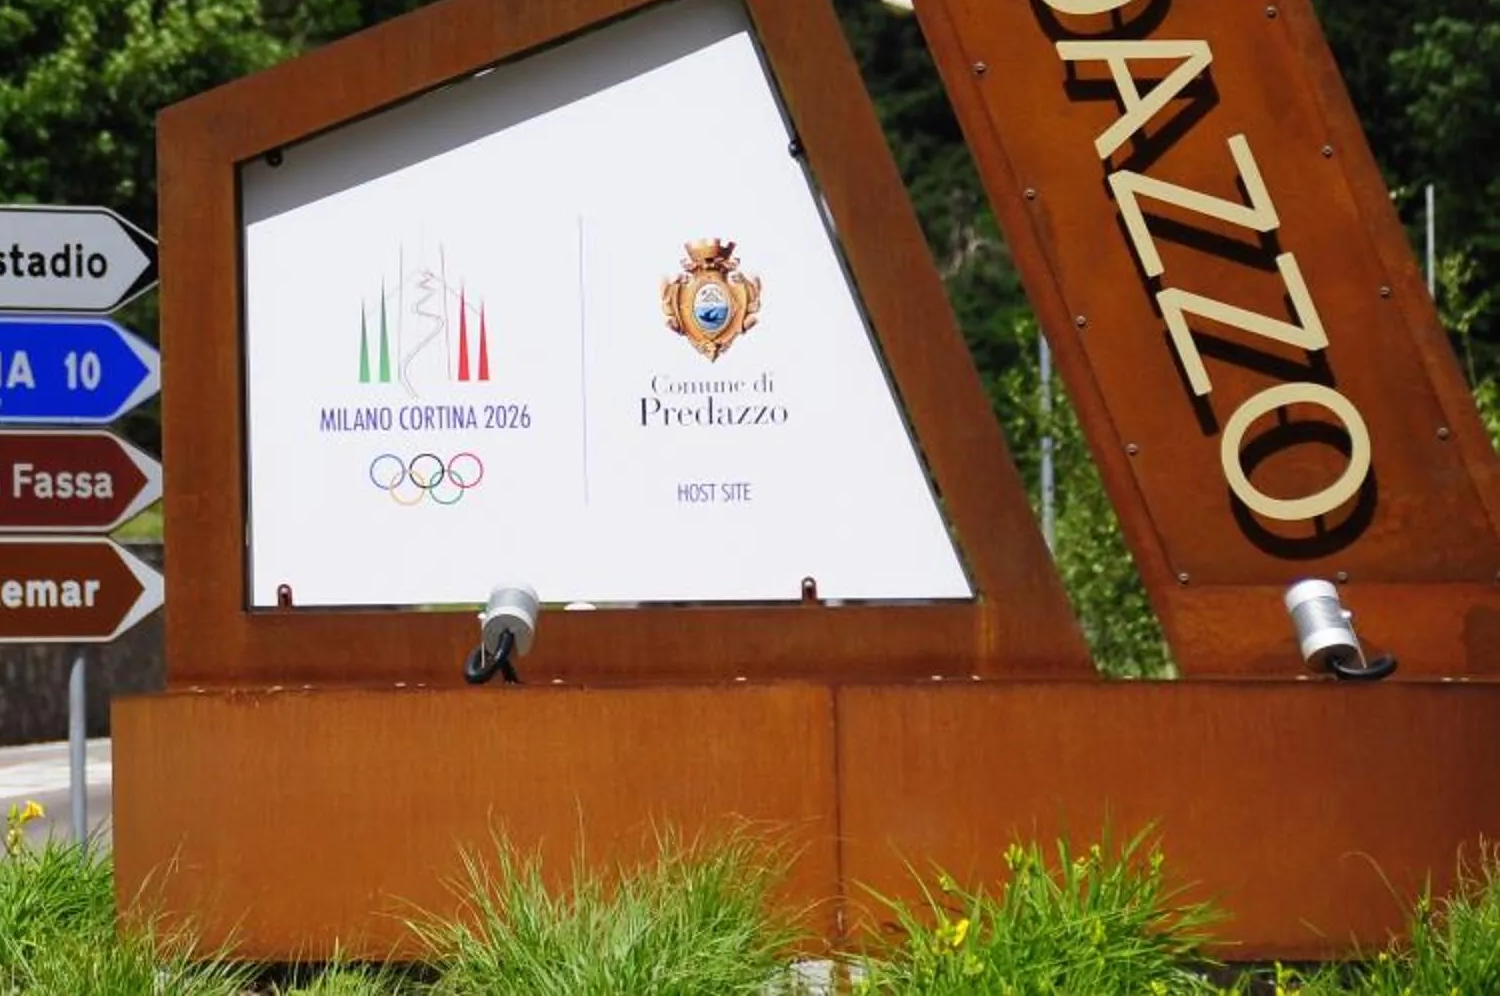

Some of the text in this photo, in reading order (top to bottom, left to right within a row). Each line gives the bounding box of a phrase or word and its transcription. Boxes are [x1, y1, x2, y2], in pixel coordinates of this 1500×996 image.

[64, 353, 101, 391] 10
[650, 372, 775, 396] Comune di
[319, 405, 532, 432] MILANO CORTINA 2026
[640, 397, 789, 428] Predazzo
[12, 464, 114, 499] Fassa
[677, 483, 752, 503] HOST SITE
